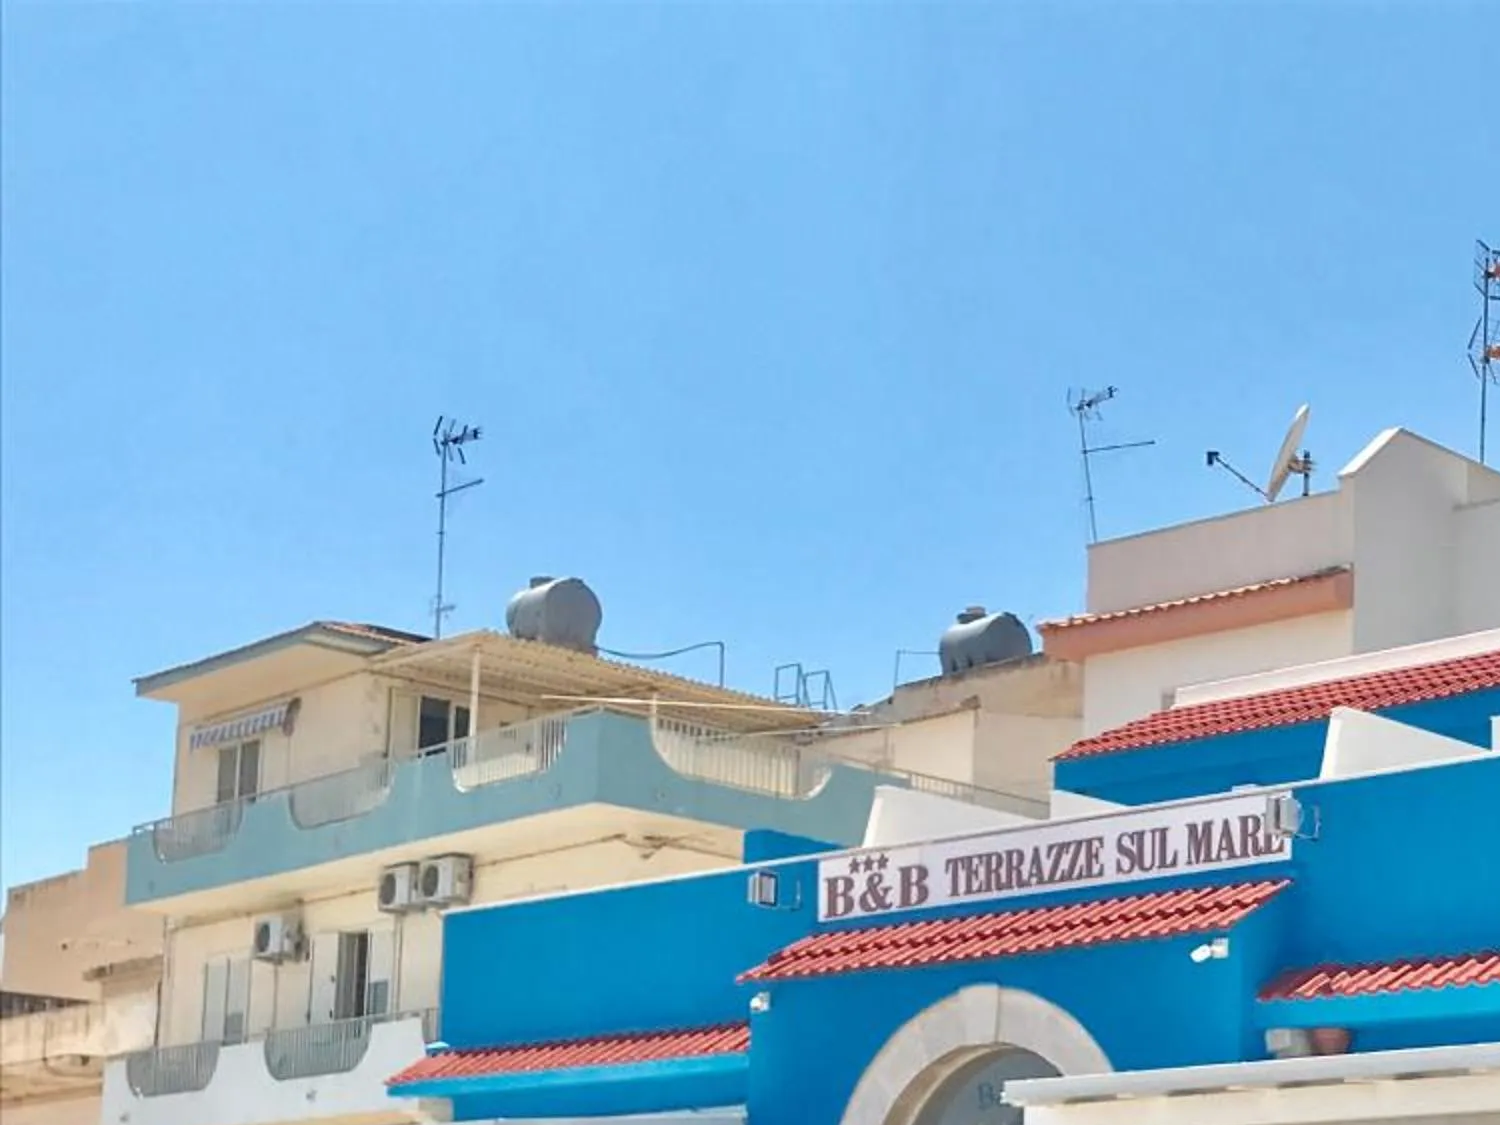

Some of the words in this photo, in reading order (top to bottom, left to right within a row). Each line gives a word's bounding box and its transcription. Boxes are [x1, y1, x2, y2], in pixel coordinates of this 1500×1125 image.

[823, 864, 930, 918] B&B
[945, 836, 1105, 897] TERRAZZE
[1116, 827, 1178, 874] SUL
[1185, 812, 1285, 866] MARE
